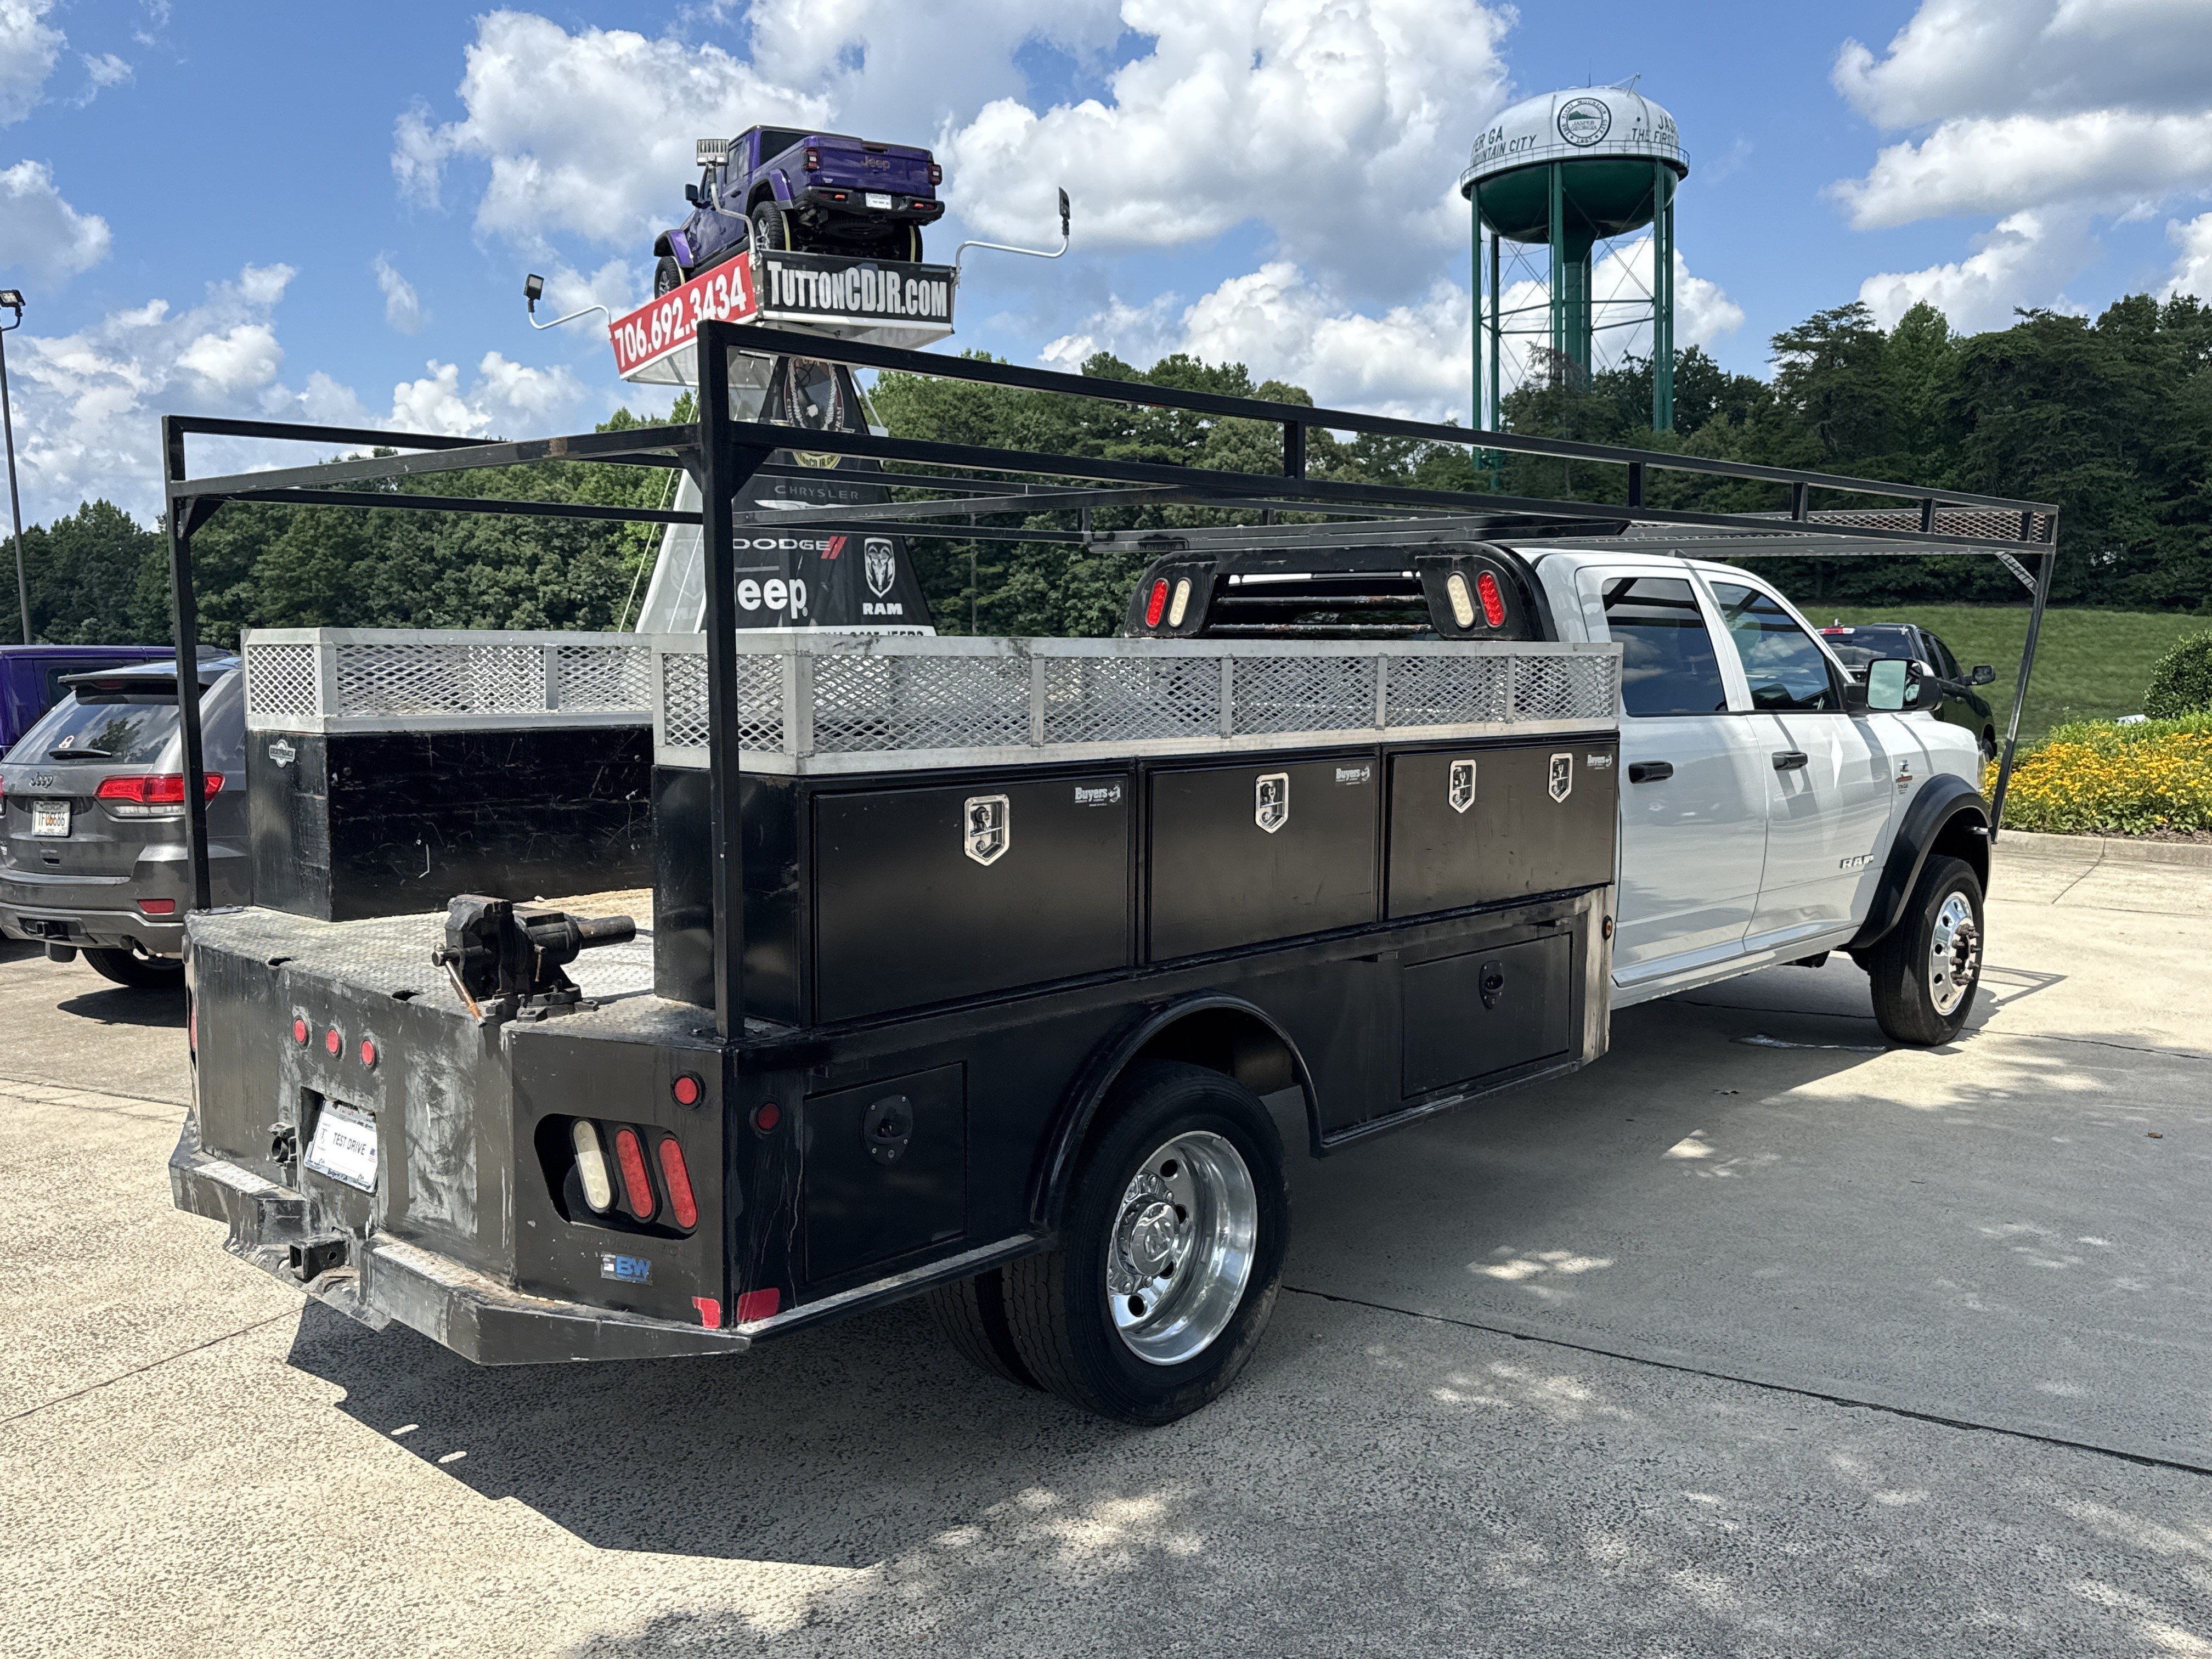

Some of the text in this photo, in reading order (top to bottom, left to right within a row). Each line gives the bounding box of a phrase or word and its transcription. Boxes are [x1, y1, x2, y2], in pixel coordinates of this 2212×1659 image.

[1488, 126, 1503, 144] GA
[1509, 134, 1537, 152] CITY
[860, 155, 891, 171] Jeep
[614, 266, 747, 368] 706.692.3434
[774, 485, 858, 500] CHRYSLER
[733, 538, 831, 551] DODGE
[737, 579, 807, 619] eep
[862, 603, 903, 615] RAM
[29, 771, 54, 789] Jeep
[1075, 787, 1108, 802] Buyers
[333, 1132, 366, 1155] TEST DRIVE
